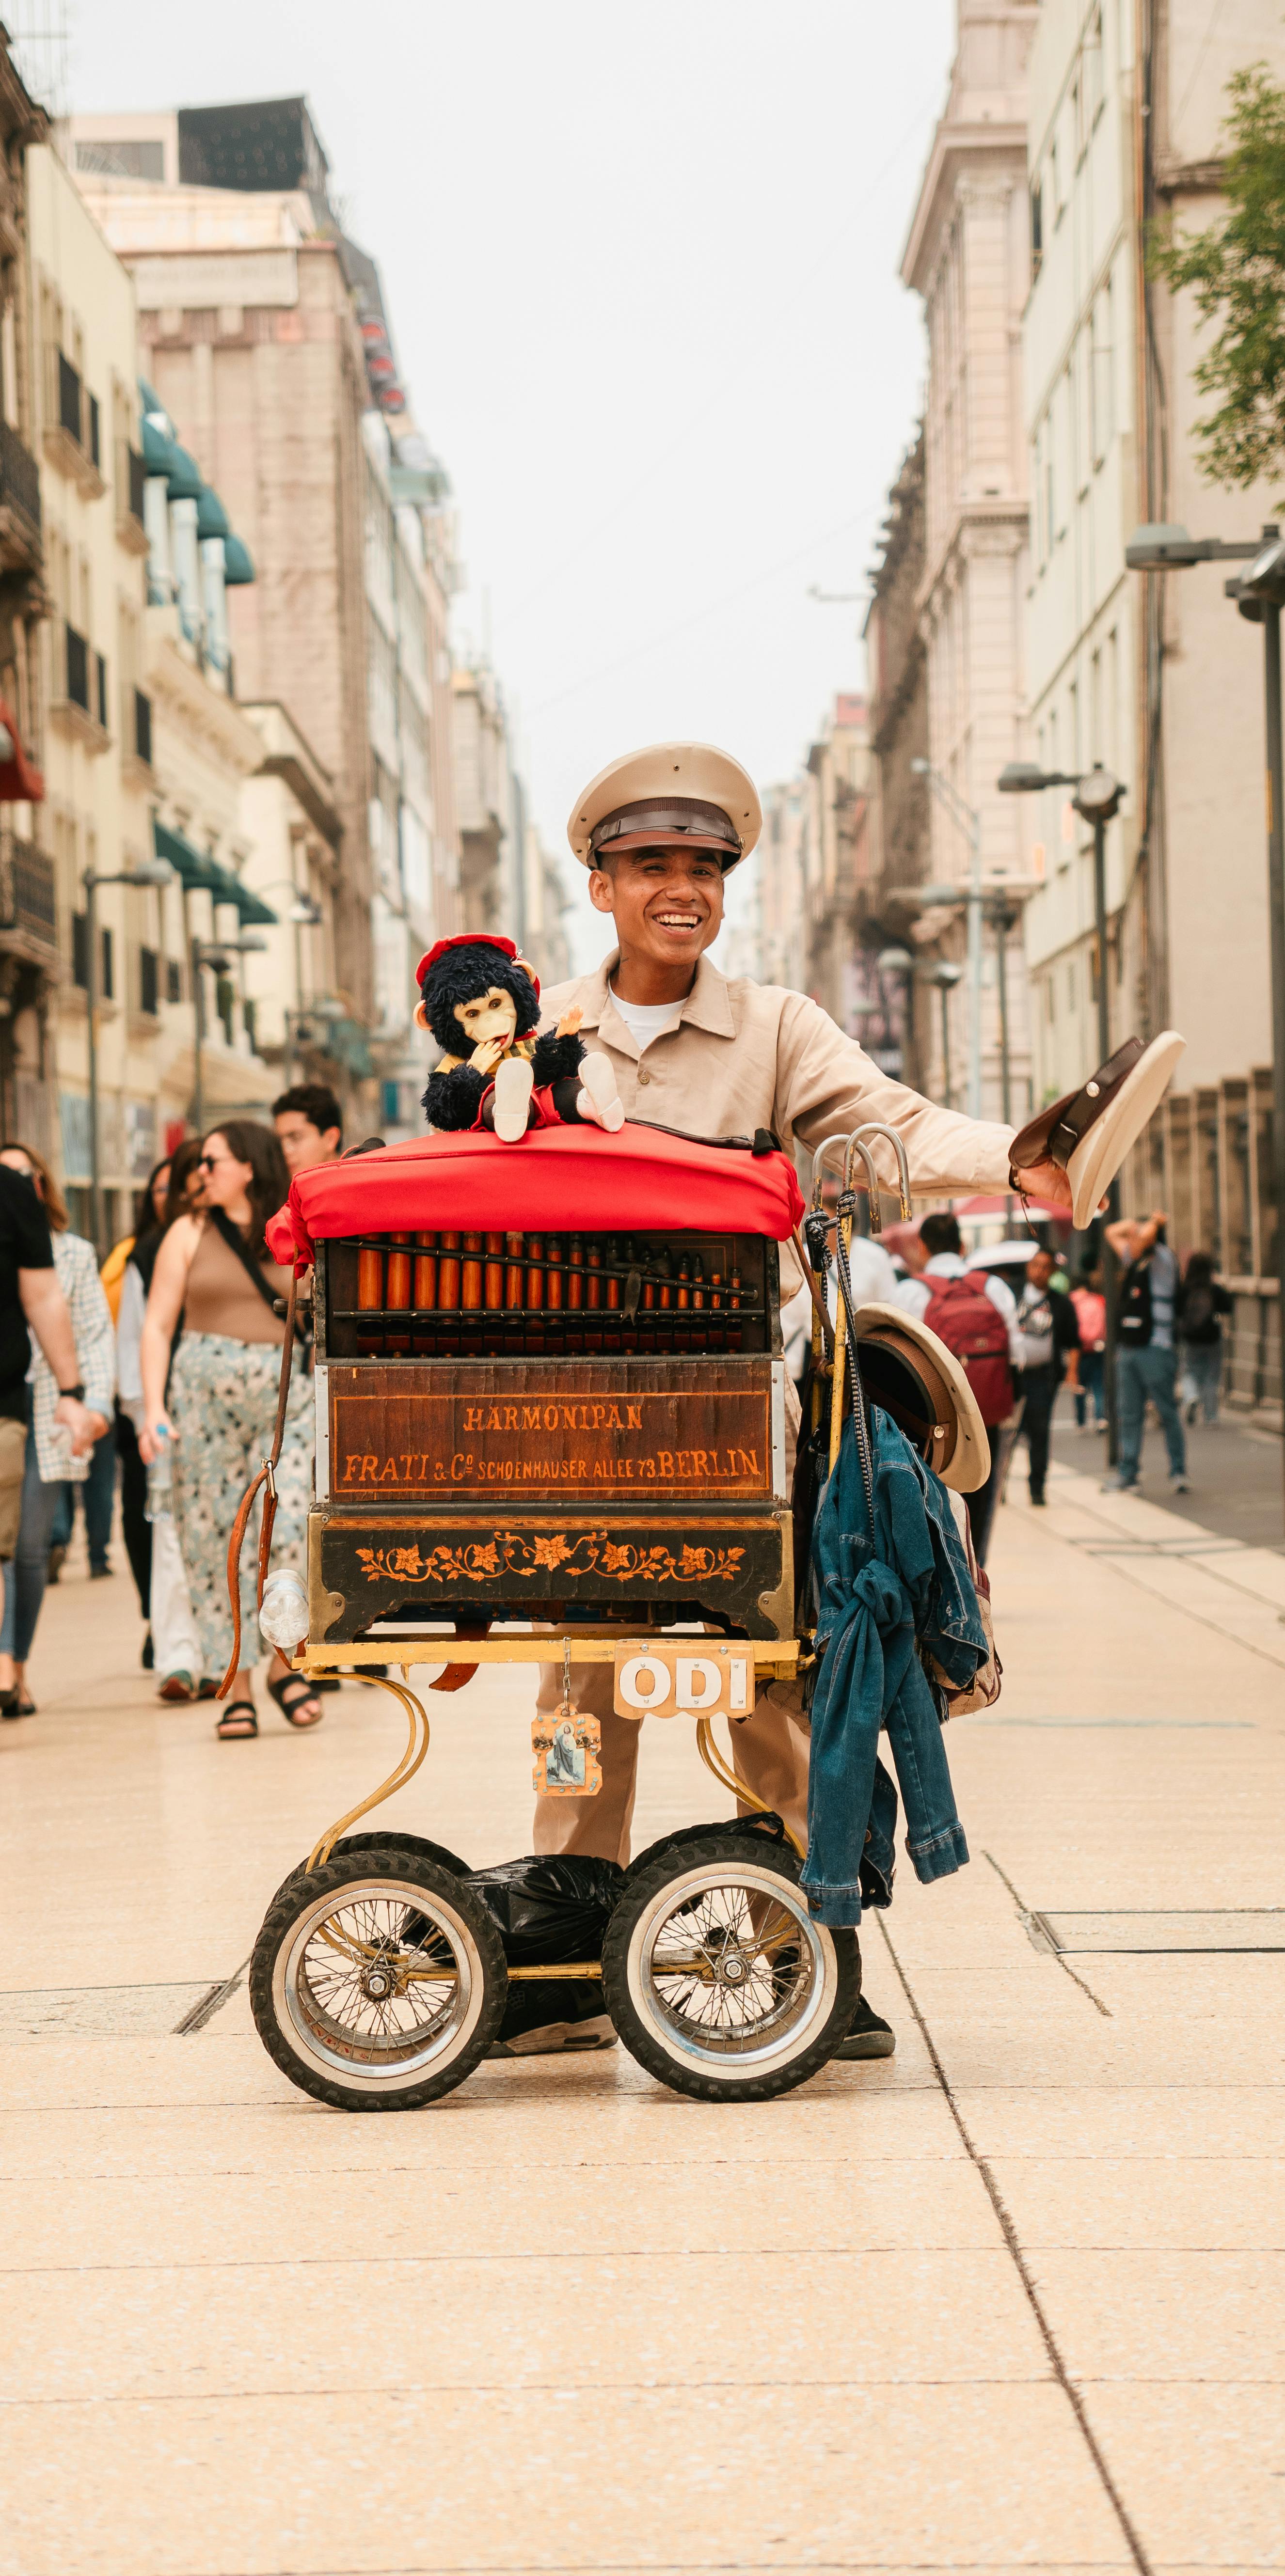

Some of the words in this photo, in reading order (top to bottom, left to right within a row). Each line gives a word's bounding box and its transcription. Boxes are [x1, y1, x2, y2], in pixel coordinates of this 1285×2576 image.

[463, 1405, 643, 1432] HARMONIPAN
[343, 1454, 429, 1482] FRATI
[434, 1462, 447, 1481] &
[477, 1460, 589, 1481] SCHOENHAUSER
[593, 1460, 635, 1478] ALLEE
[637, 1459, 656, 1478] 73
[657, 1449, 761, 1479] BERLIN
[619, 1656, 747, 1709] ODI
